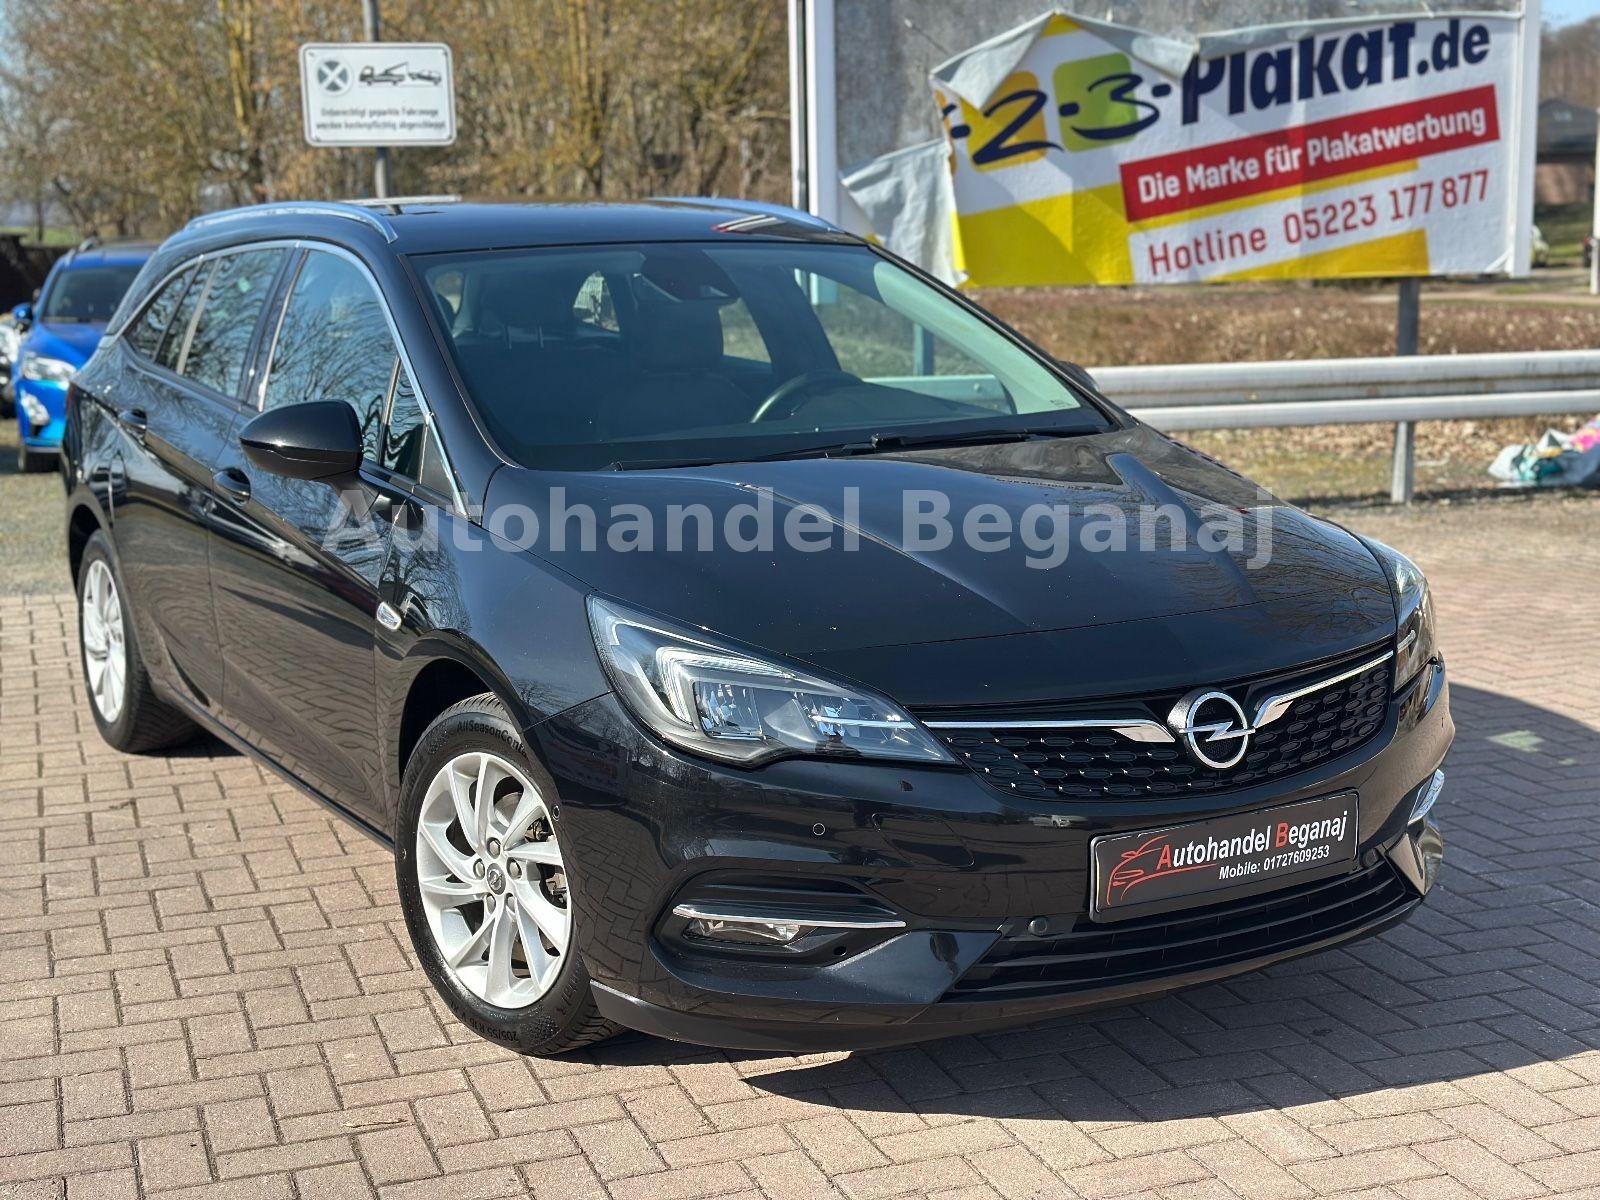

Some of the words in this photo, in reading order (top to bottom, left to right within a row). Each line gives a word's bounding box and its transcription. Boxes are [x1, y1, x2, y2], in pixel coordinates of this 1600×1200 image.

[1137, 173, 1180, 204] Die
[1186, 154, 1260, 194] Marke
[1264, 144, 1302, 177] für
[1306, 106, 1487, 167] Plakatwerbung
[1148, 227, 1267, 276] Hotline
[1283, 194, 1377, 244] 05223
[1389, 181, 1434, 221] 177
[1441, 169, 1490, 209] 877
[1156, 824, 1271, 871] Autohandel
[1274, 810, 1348, 849] Beganaj
[1218, 861, 1260, 881] Mobile:
[1263, 844, 1331, 872] 01727609253
